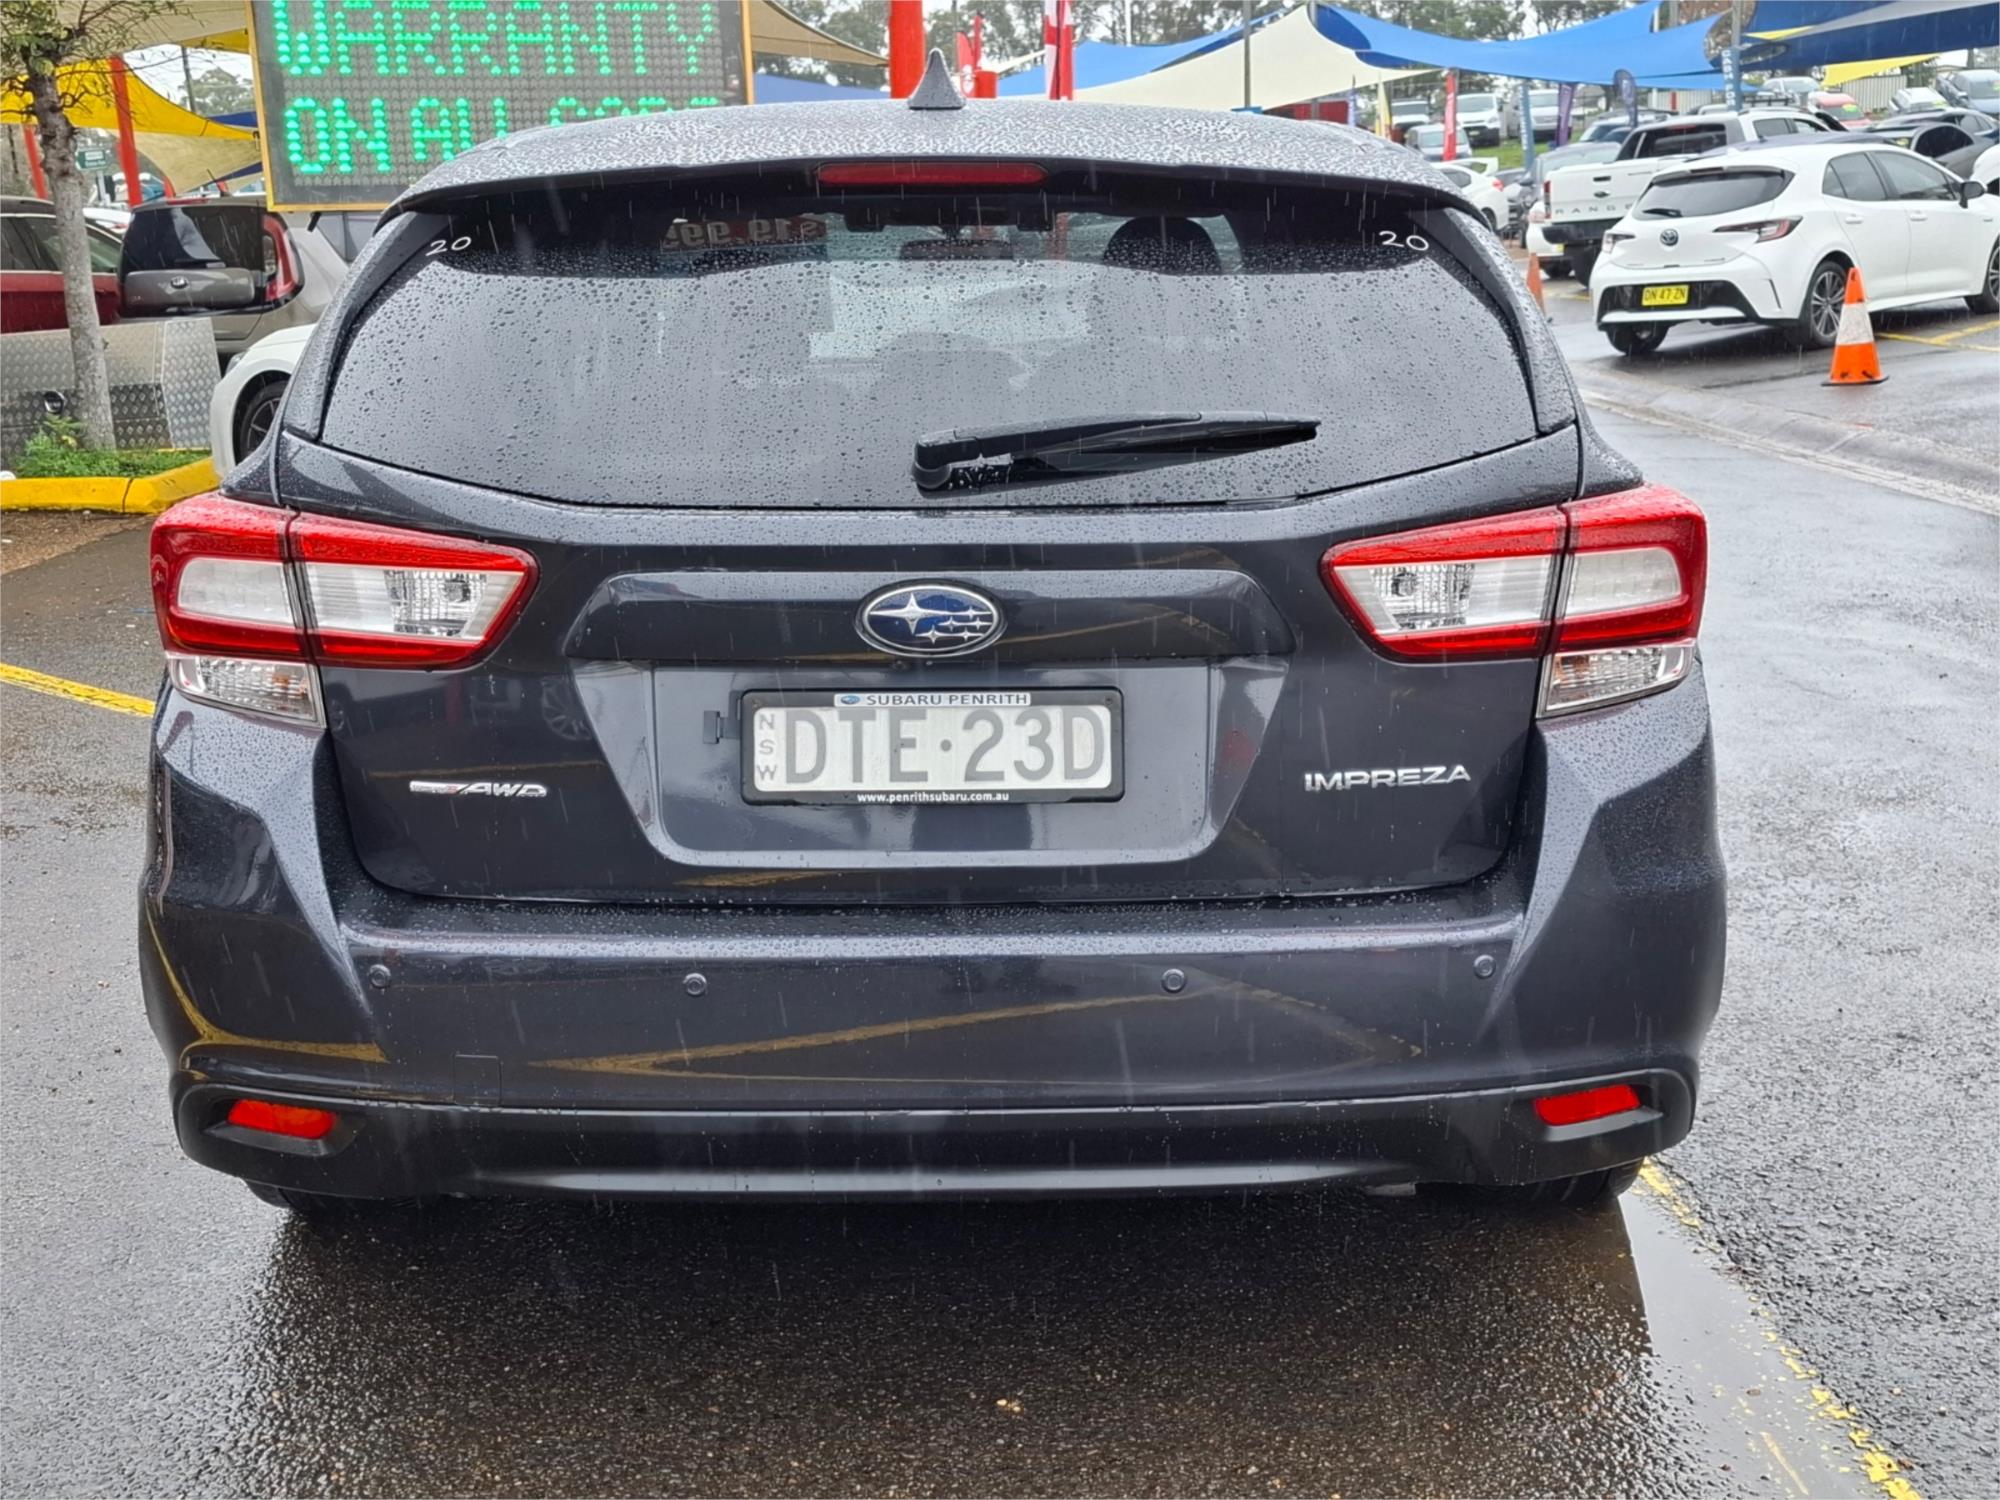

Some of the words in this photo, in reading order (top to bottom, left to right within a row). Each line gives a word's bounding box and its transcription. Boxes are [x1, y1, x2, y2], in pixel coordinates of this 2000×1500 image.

[272, 0, 714, 75] WARRANTY
[284, 97, 392, 173] ON
[425, 236, 472, 257] 20
[1379, 230, 1429, 251] 20
[866, 694, 942, 706] SUBARU
[949, 693, 1028, 705] PENRITH
[1304, 764, 1472, 792] IMPREZA
[461, 782, 548, 797] AWD
[857, 791, 1010, 804] www.penrithsubaru.com.au
